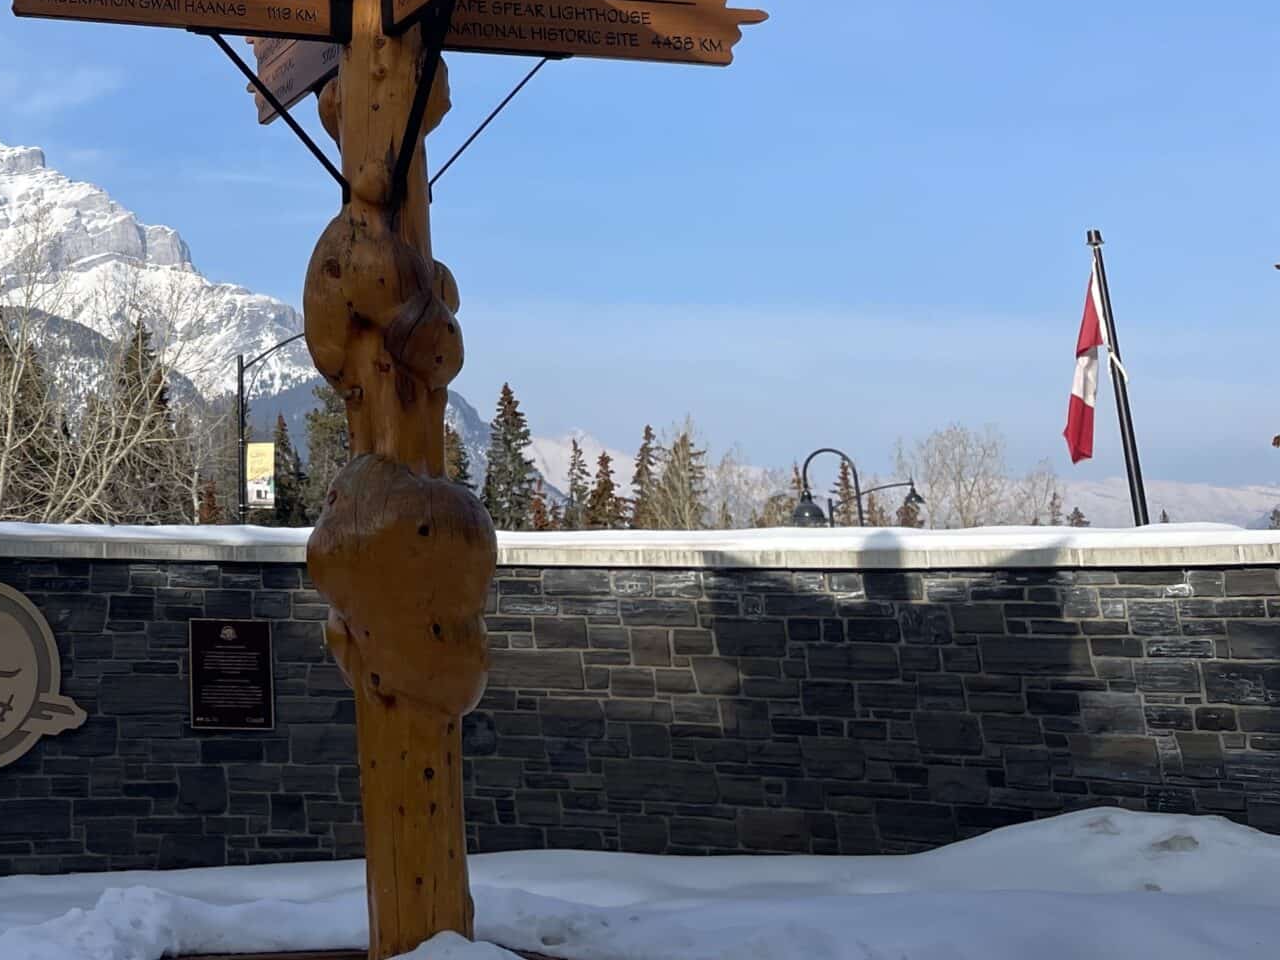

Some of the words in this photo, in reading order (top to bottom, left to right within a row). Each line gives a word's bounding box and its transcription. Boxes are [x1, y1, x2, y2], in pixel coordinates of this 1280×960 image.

[184, 0, 247, 16] HAANAS
[295, 8, 318, 22] KM
[491, 1, 545, 18] SPEAR
[549, 4, 652, 25] LIGHTHOUSE
[448, 22, 527, 40] NATIONAL
[531, 26, 601, 45] HISTORIC
[606, 30, 641, 47] SITE
[700, 37, 723, 52] KM
